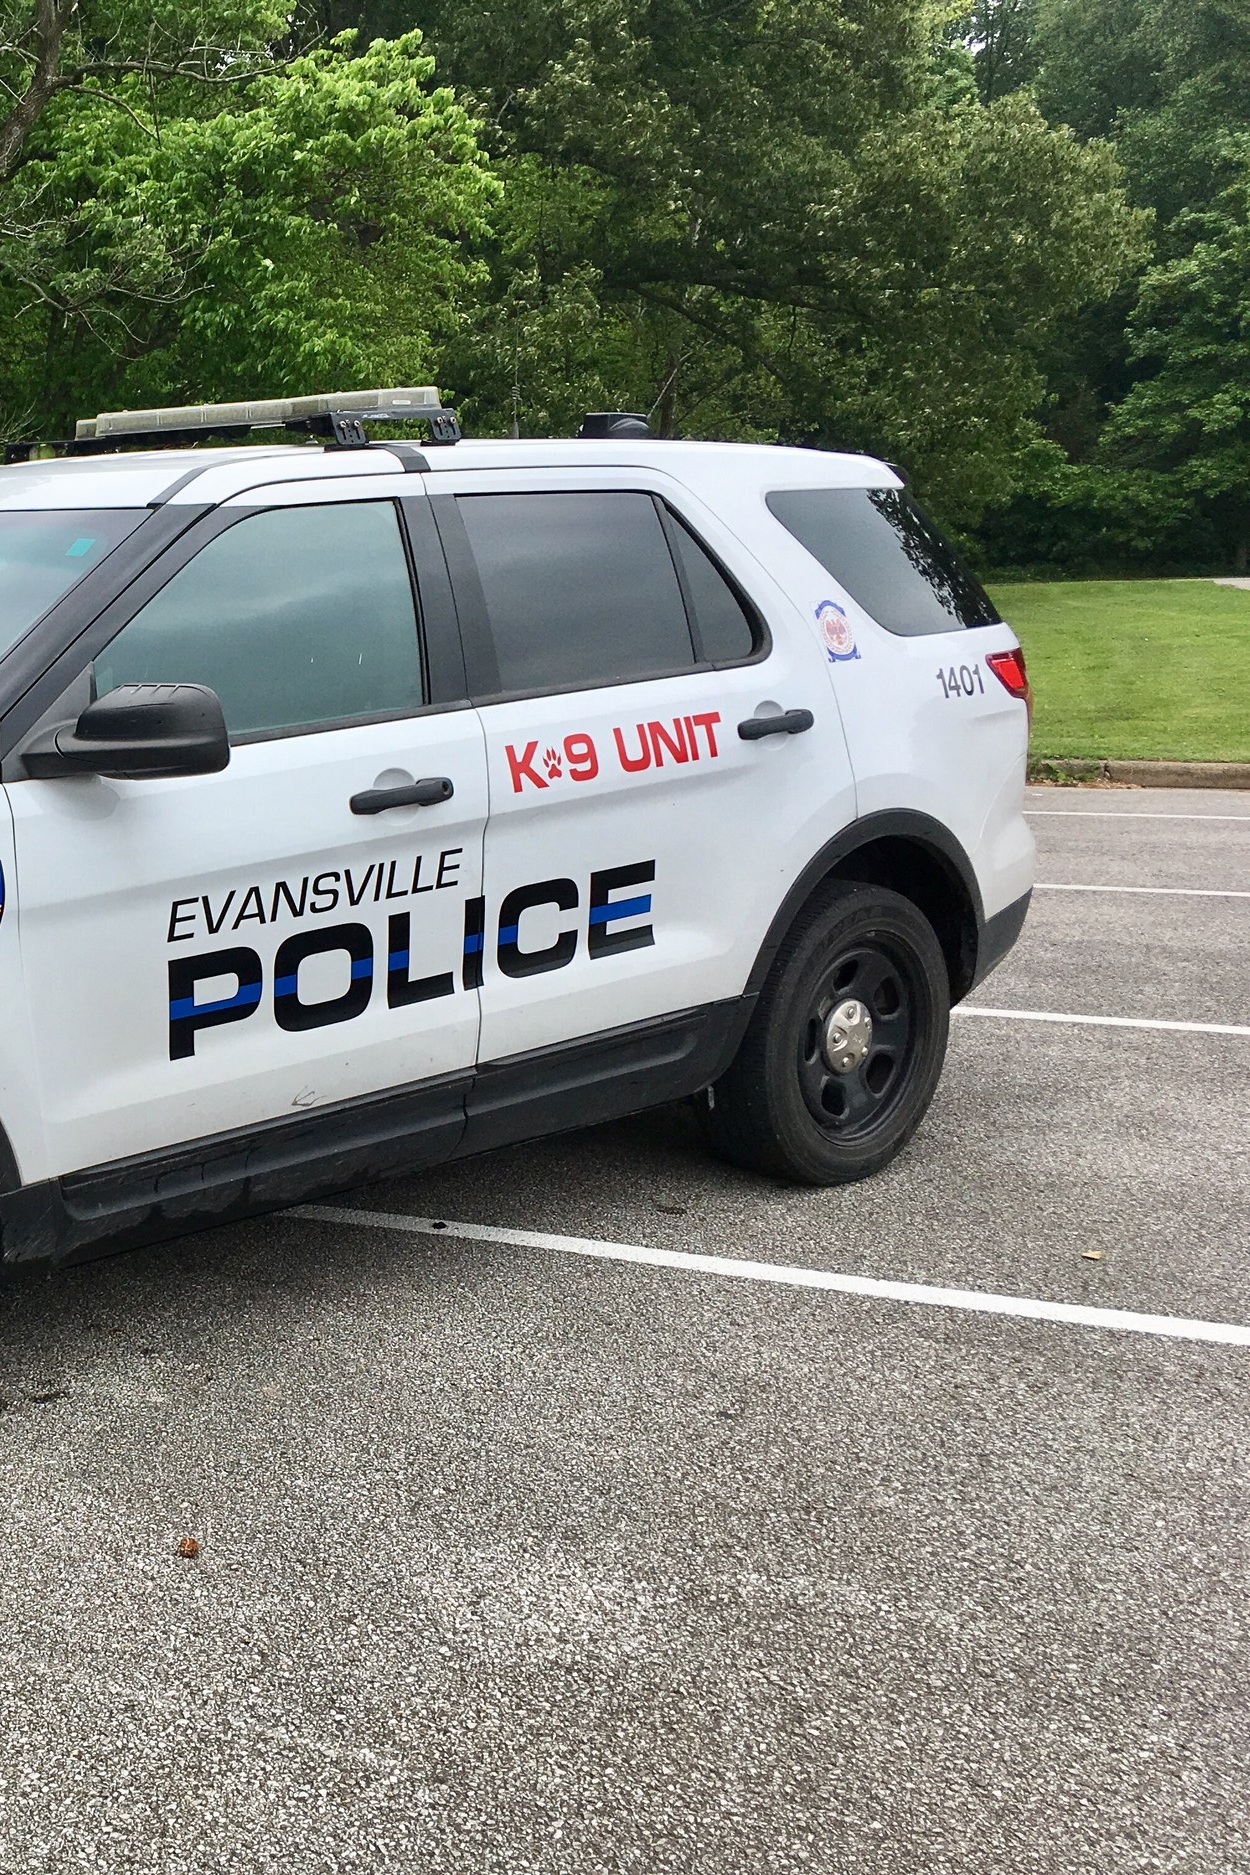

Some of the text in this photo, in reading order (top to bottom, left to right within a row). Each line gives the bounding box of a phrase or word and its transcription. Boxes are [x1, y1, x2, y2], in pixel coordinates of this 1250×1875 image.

[936, 664, 985, 699] 1401
[612, 711, 721, 773] UNIT
[167, 848, 463, 943] EVANSVILLE
[168, 859, 656, 1061] POLICE
